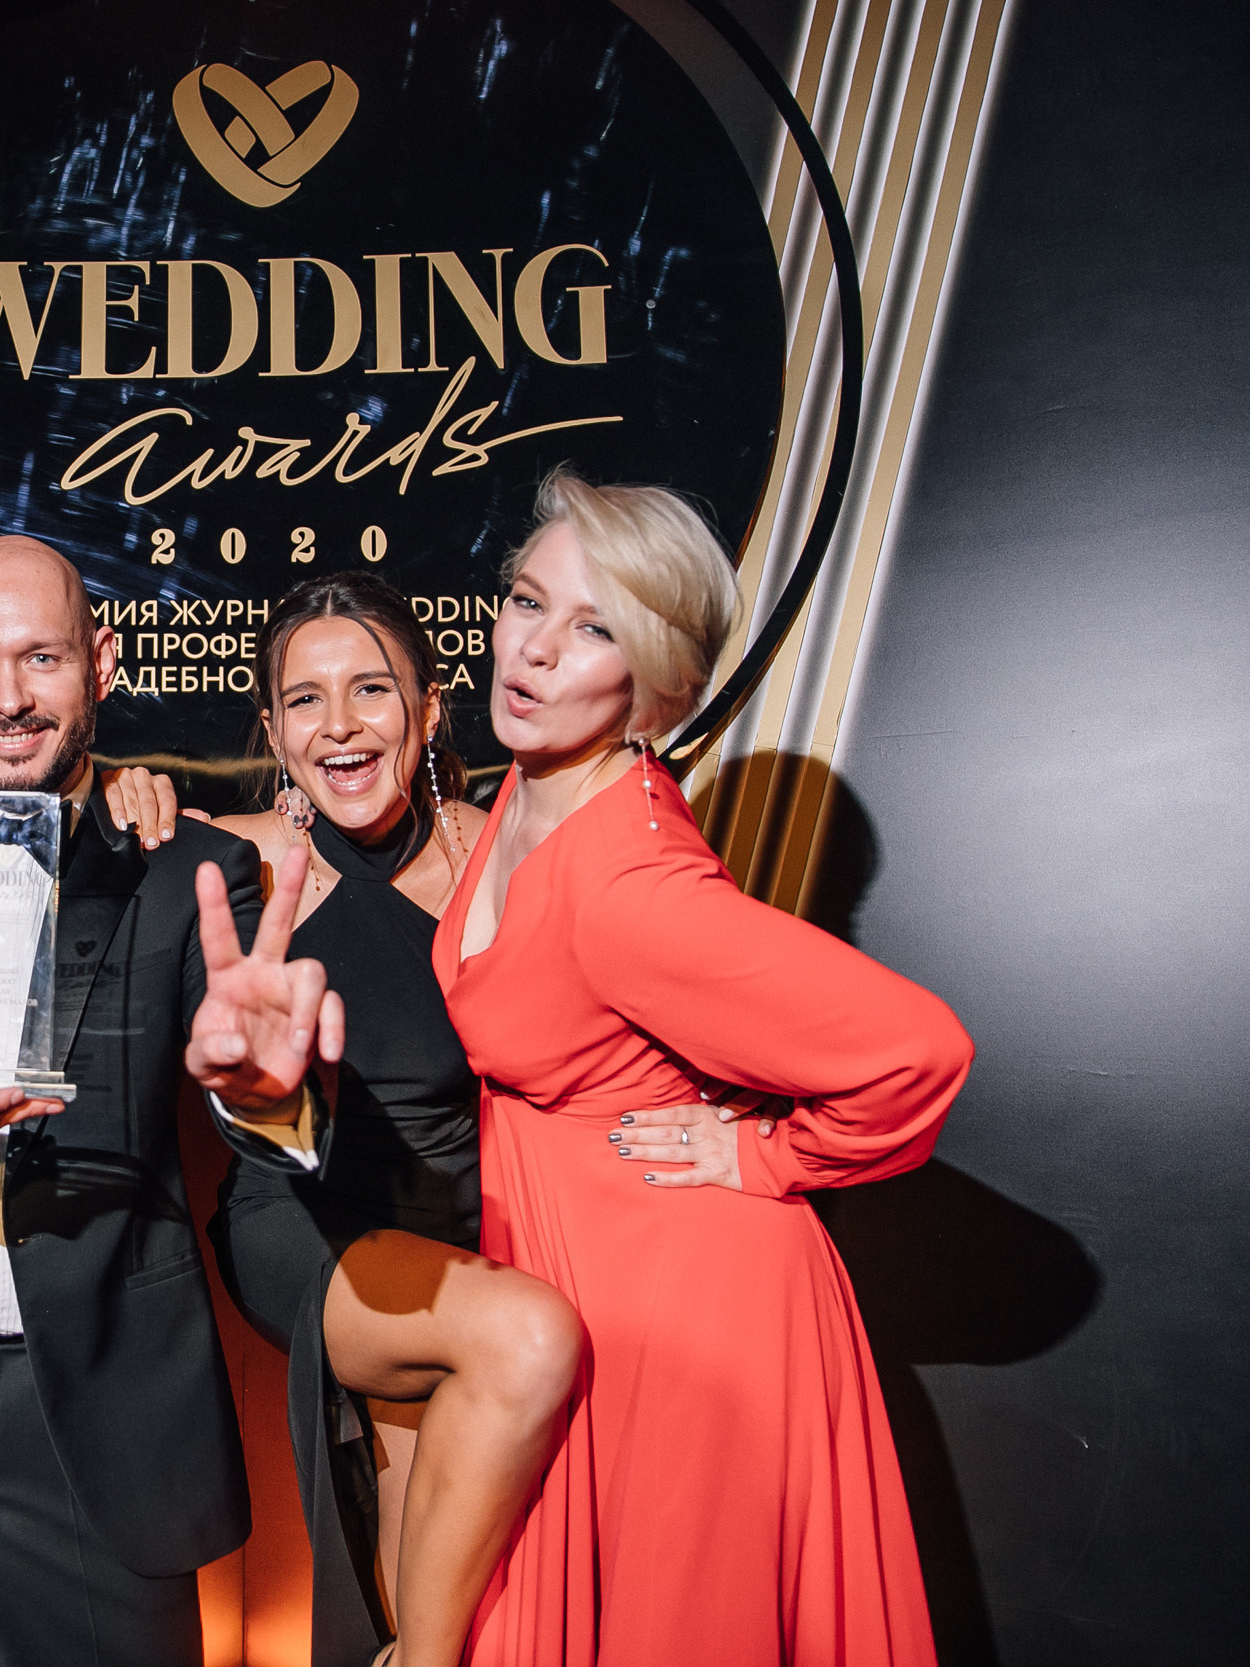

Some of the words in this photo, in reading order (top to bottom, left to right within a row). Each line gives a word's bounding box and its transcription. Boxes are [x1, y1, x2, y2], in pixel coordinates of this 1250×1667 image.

[60, 356, 624, 505] awards
[90, 600, 157, 625] МИЯ
[169, 599, 285, 625] ЖУРН
[411, 595, 510, 622] DDIN
[137, 632, 257, 659] ПРОФЕ
[109, 665, 254, 697] АДЕБНО
